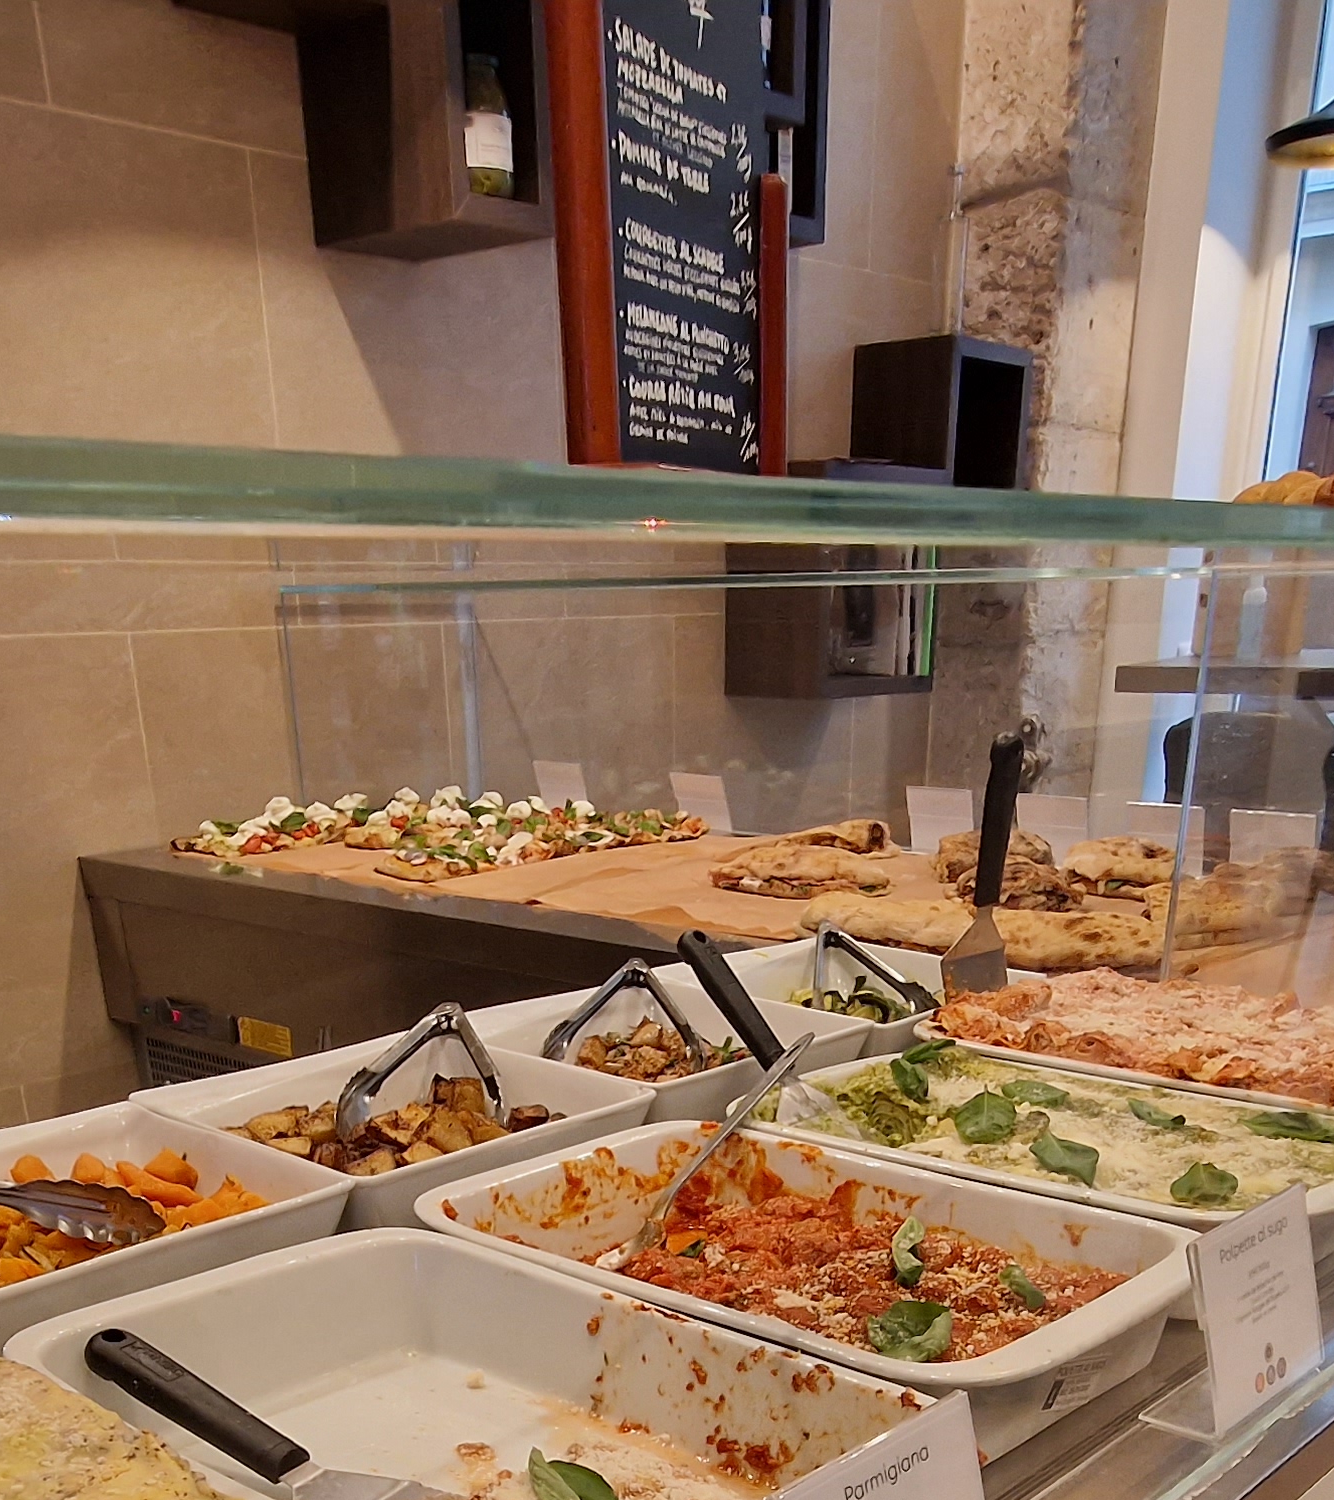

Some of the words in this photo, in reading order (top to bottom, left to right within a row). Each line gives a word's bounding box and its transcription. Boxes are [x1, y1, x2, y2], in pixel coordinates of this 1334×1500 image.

[1219, 1234, 1257, 1265] Polpette
[1257, 1225, 1266, 1243] al
[1267, 1216, 1289, 1237] sugo
